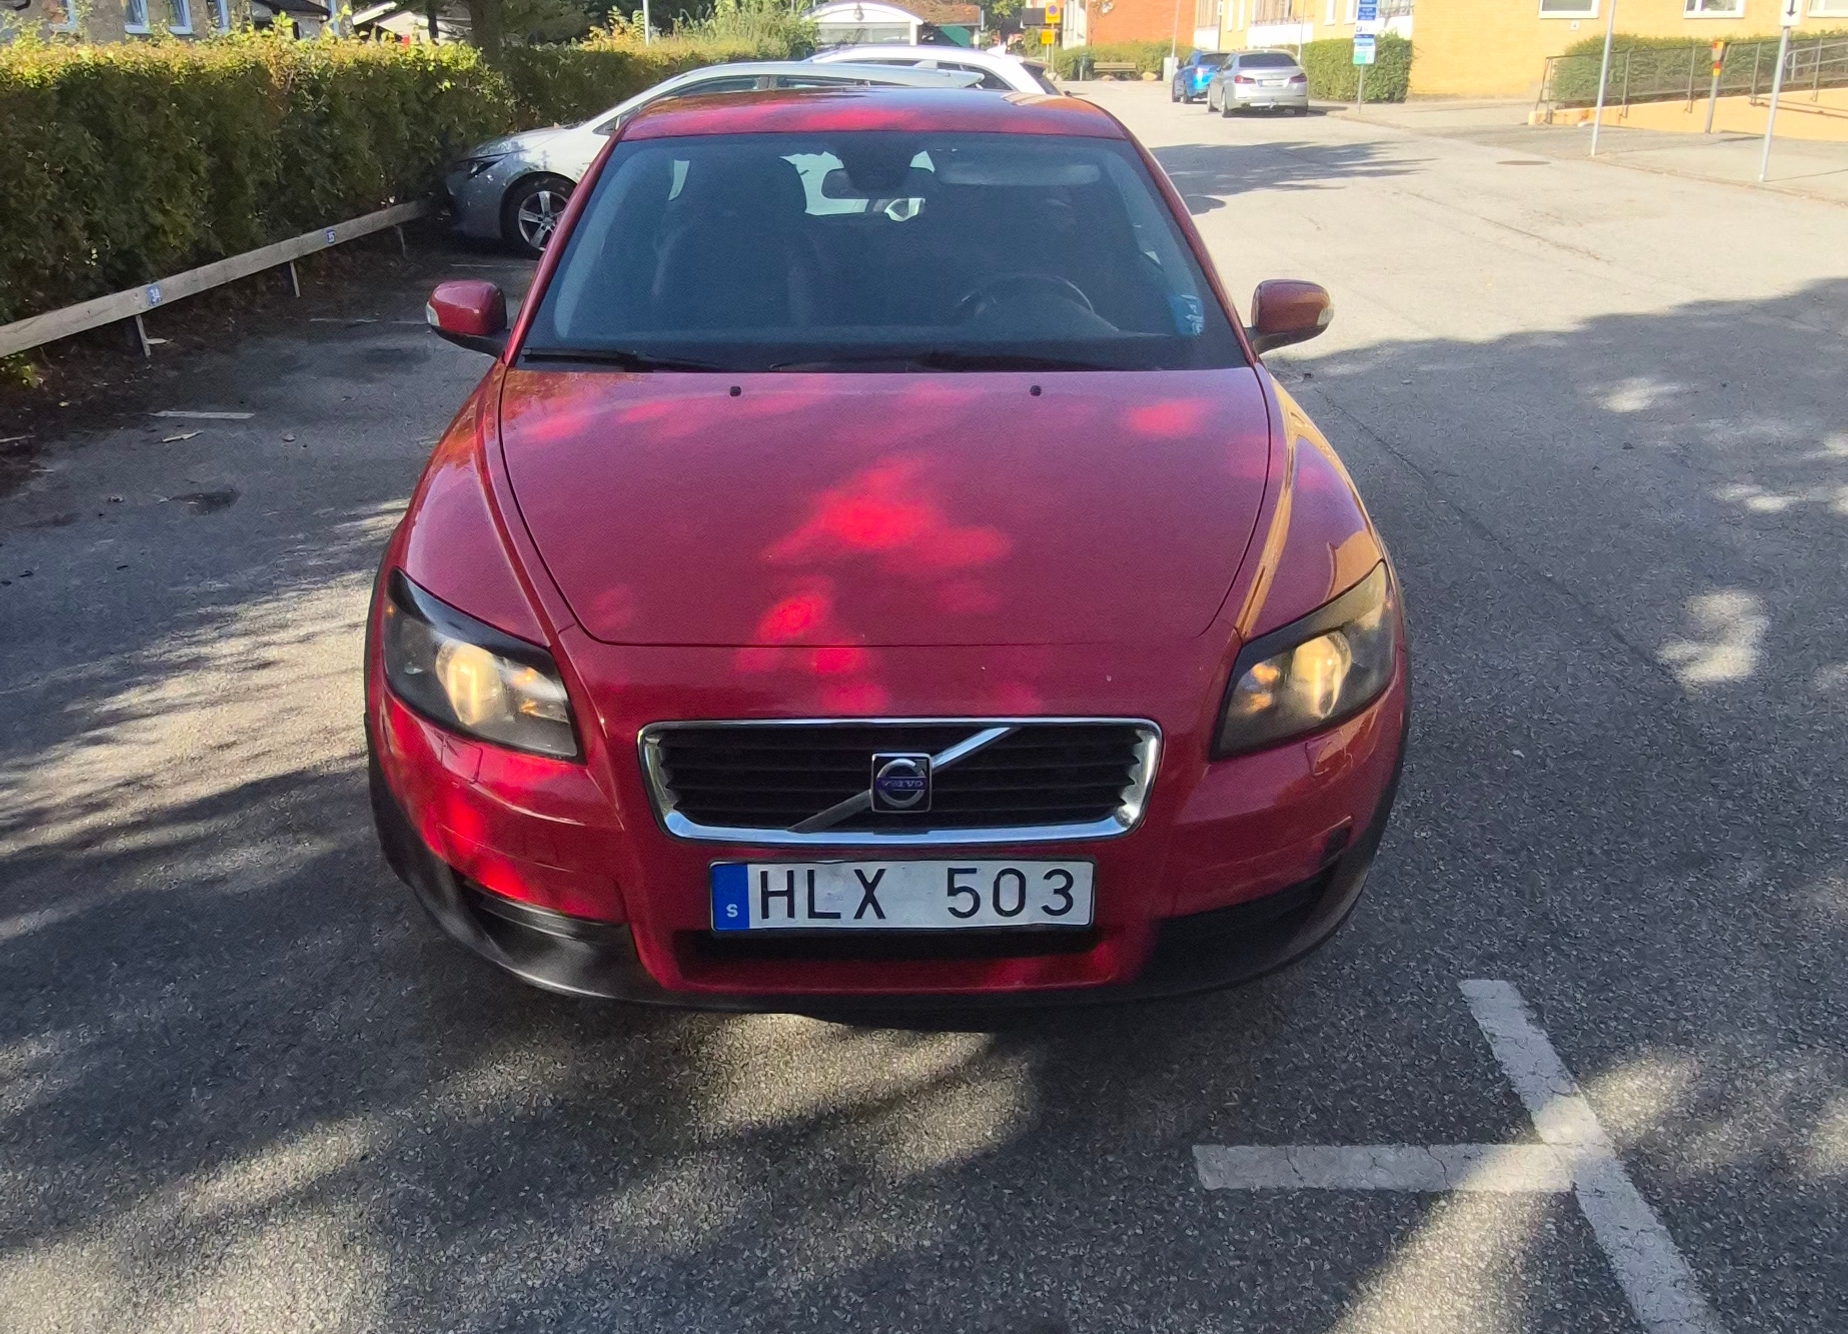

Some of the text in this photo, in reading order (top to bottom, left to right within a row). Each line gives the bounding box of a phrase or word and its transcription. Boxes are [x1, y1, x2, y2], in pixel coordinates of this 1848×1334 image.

[726, 867, 1075, 920] S HLX 503
